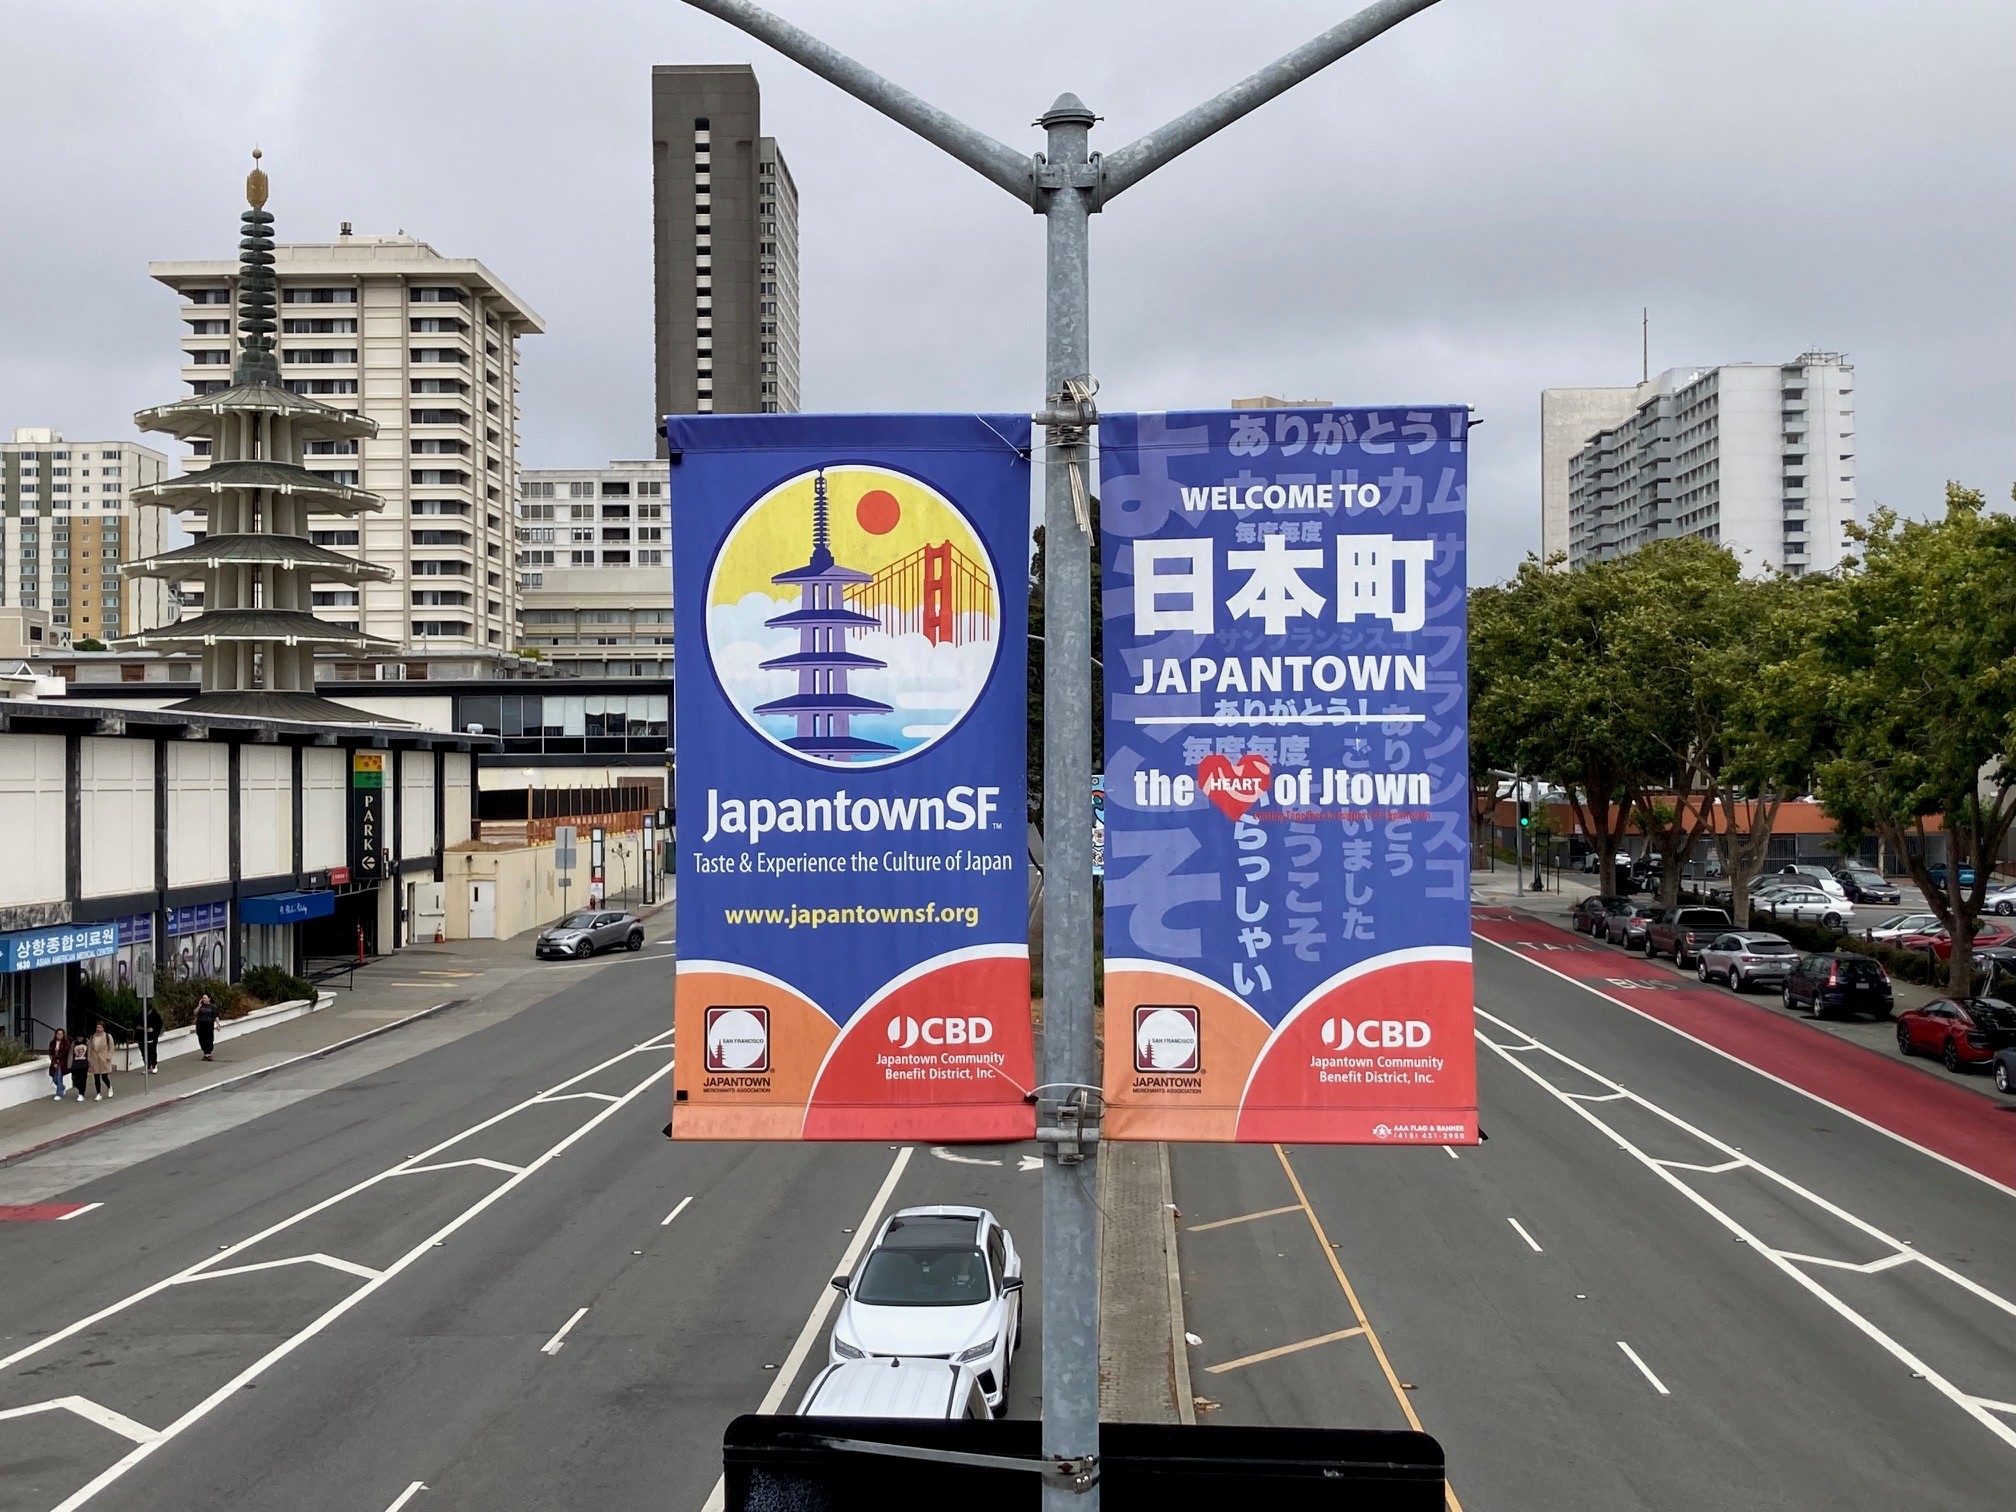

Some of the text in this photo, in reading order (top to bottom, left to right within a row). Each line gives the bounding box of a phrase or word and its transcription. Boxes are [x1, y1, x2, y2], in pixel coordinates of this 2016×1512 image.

[1180, 483, 1381, 512] WELCOME TO
[1133, 534, 1434, 636] 日本町
[1134, 654, 1426, 695] JAPANTOWN
[1133, 768, 1431, 806] the HEART of Jtown
[363, 795, 374, 851] PARK
[702, 785, 1000, 845] JapantownSF
[693, 850, 1013, 878] Taste & Experience the Culture of Japan
[724, 902, 979, 929] www.japantownsf.org
[16, 927, 114, 959] 상항종합의료원
[35, 956, 51, 968] ASIAN
[52, 952, 76, 964] AMERICAN
[76, 949, 96, 960] MEDICAL
[96, 946, 114, 957] CENTER
[1604, 977, 1679, 991] BUS
[876, 1052, 1005, 1066] Japantown Community
[1310, 1055, 1444, 1070] Japantown Community
[703, 1077, 771, 1088] JAPANTOWN
[885, 1067, 997, 1081] Benefit District, Inc.
[1132, 1077, 1202, 1088] JAPANTOWN
[1319, 1071, 1435, 1084] Benefit District, Inc.
